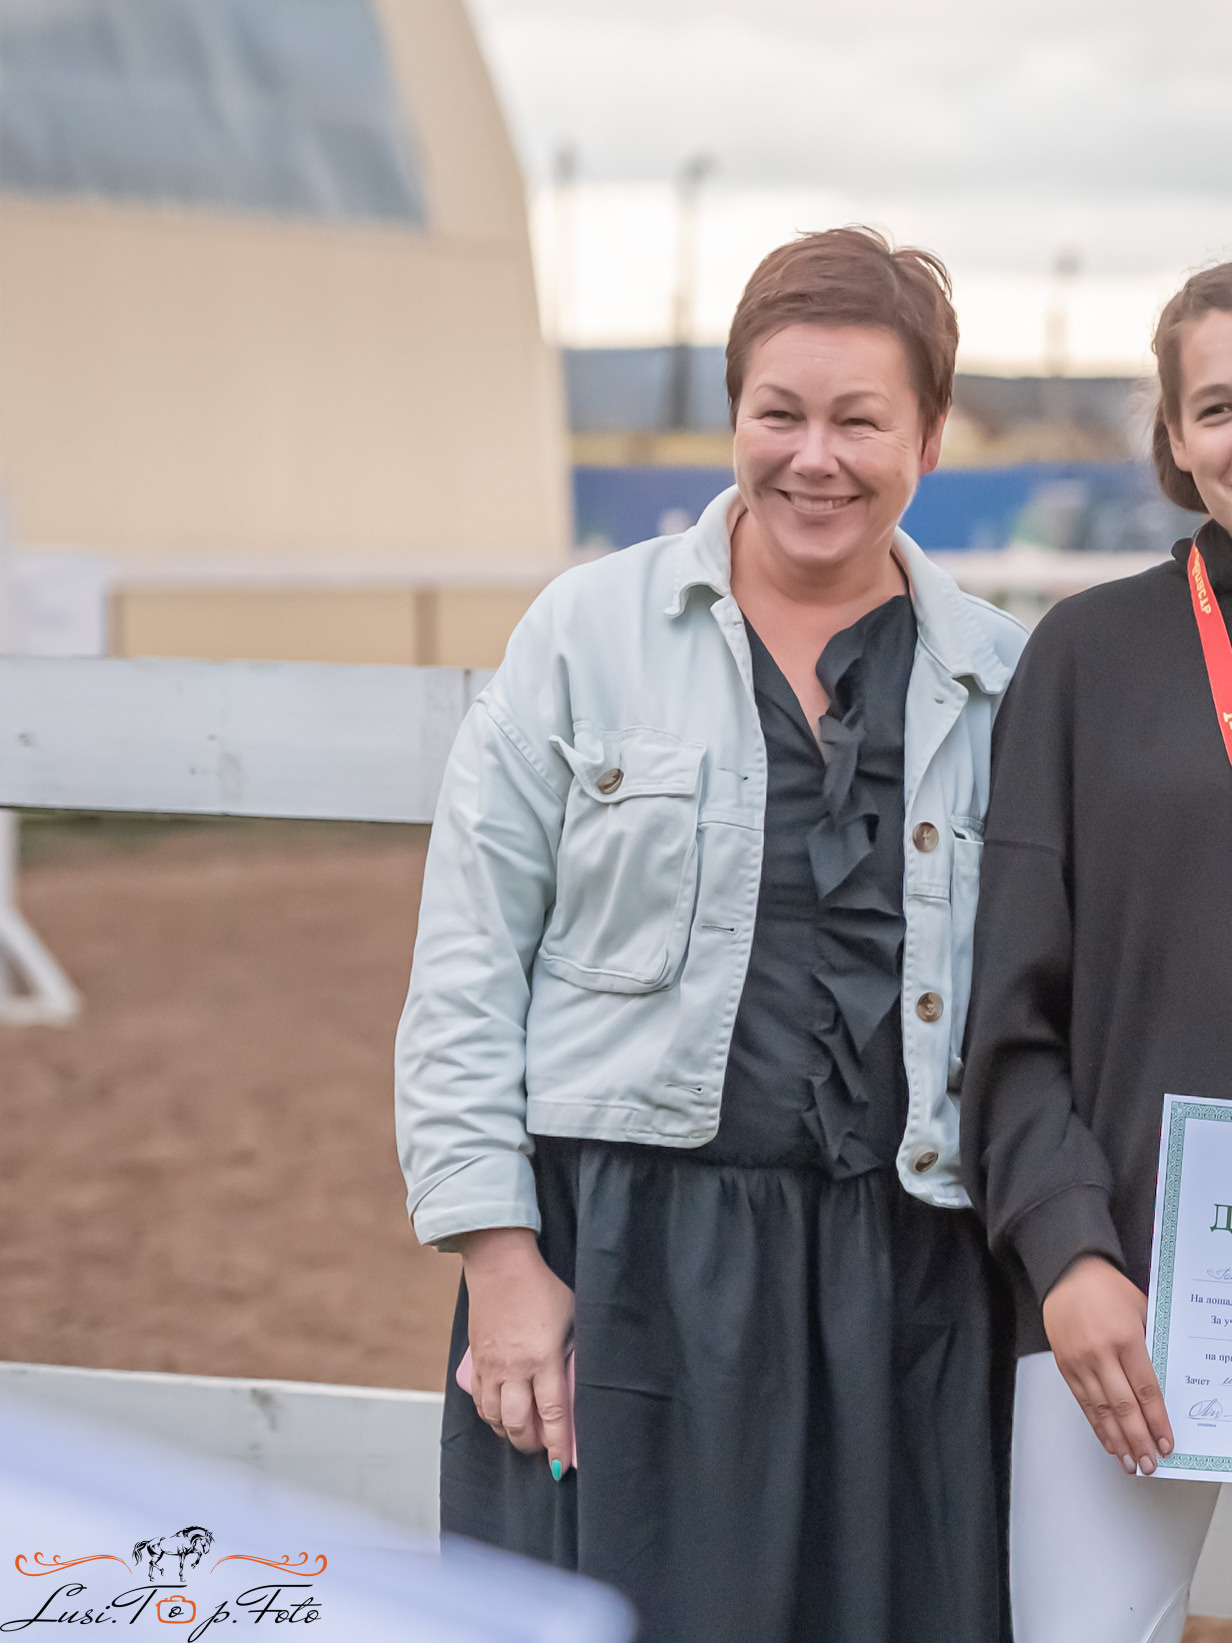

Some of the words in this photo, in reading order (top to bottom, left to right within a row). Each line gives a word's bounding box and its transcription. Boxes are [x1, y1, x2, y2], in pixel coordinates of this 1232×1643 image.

[1191, 1294, 1203, 1303] На
[1211, 1316, 1221, 1325] За
[1205, 1353, 1216, 1361] на
[1185, 1376, 1210, 1386] Зачет
